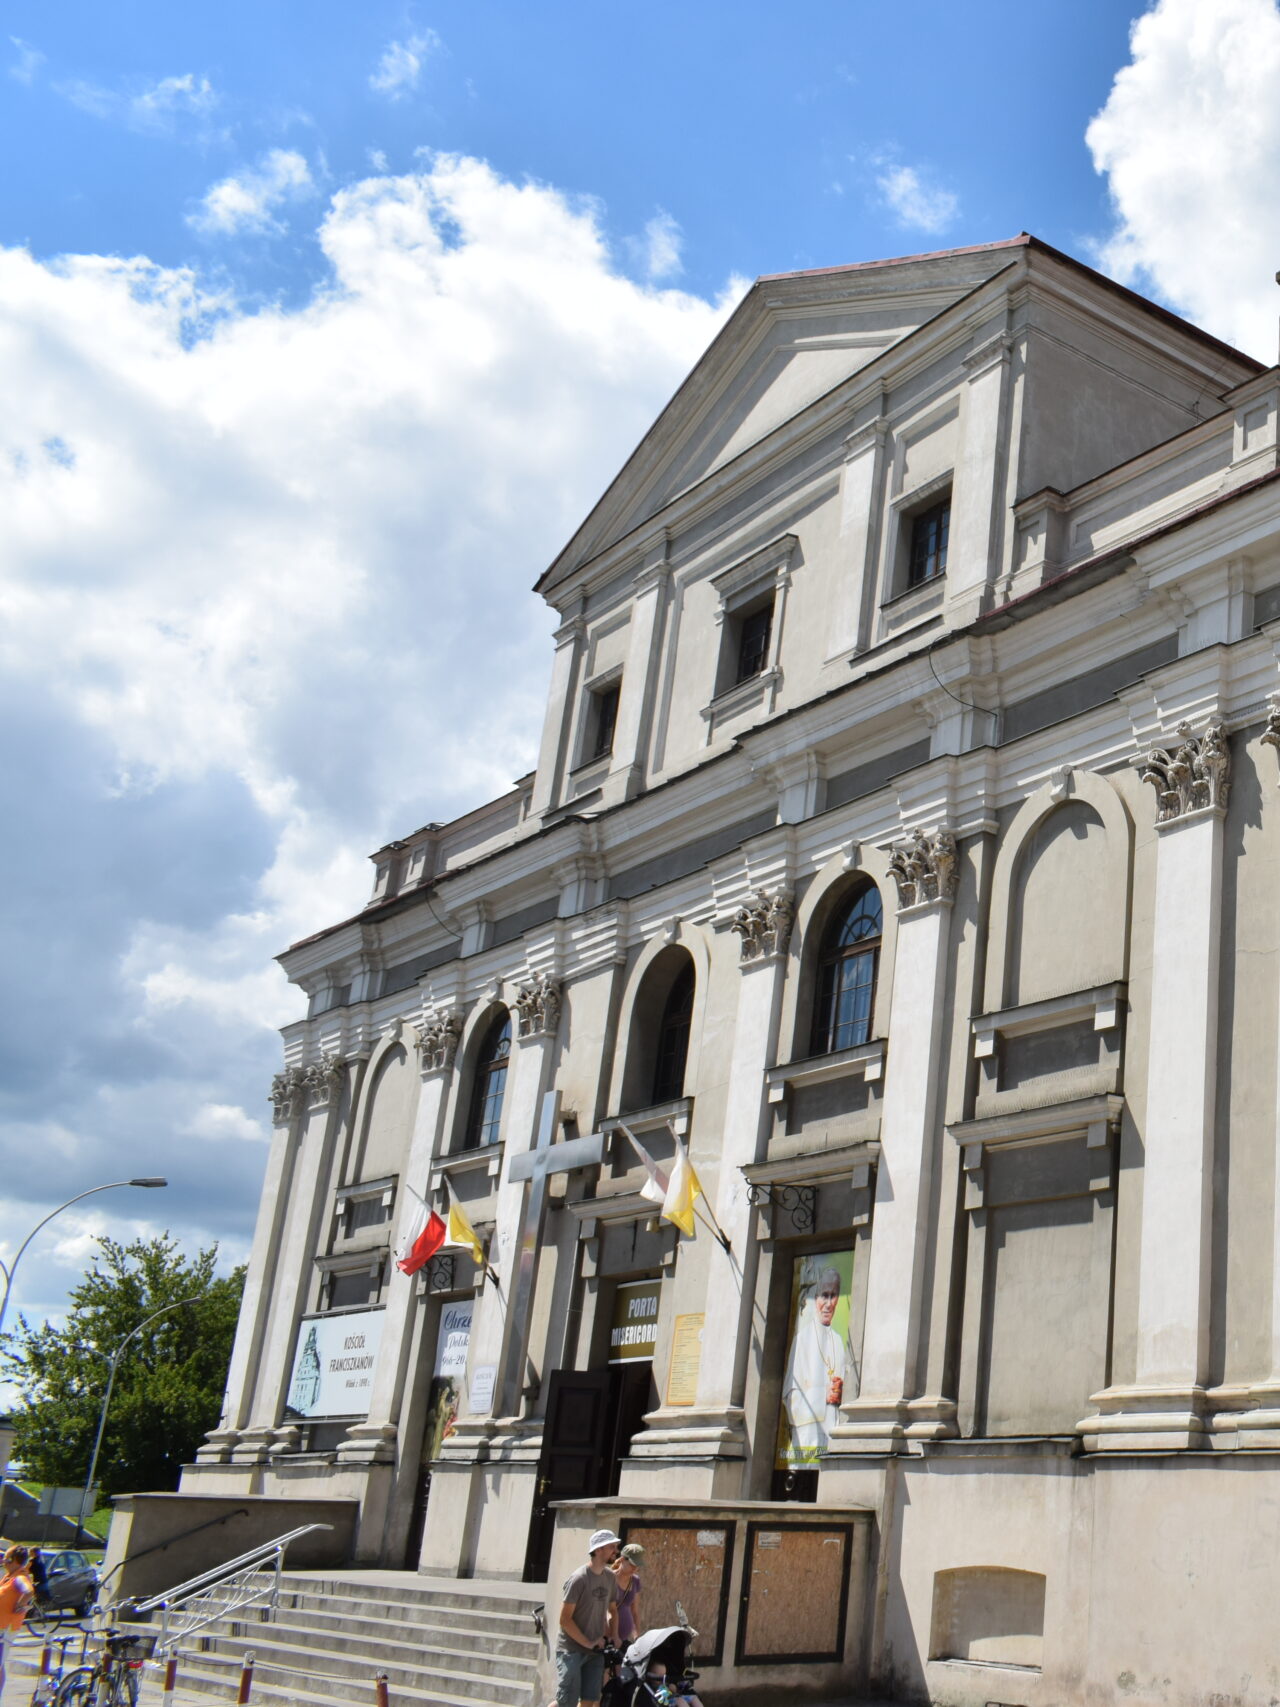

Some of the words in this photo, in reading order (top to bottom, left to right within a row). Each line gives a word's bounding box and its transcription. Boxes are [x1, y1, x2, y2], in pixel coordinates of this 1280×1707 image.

[628, 1296, 657, 1318] PORTA
[344, 1331, 366, 1350] KOŚCIÓŁ
[611, 1323, 657, 1346] MISERICORD
[329, 1353, 374, 1372] FRANCISZKANÓW
